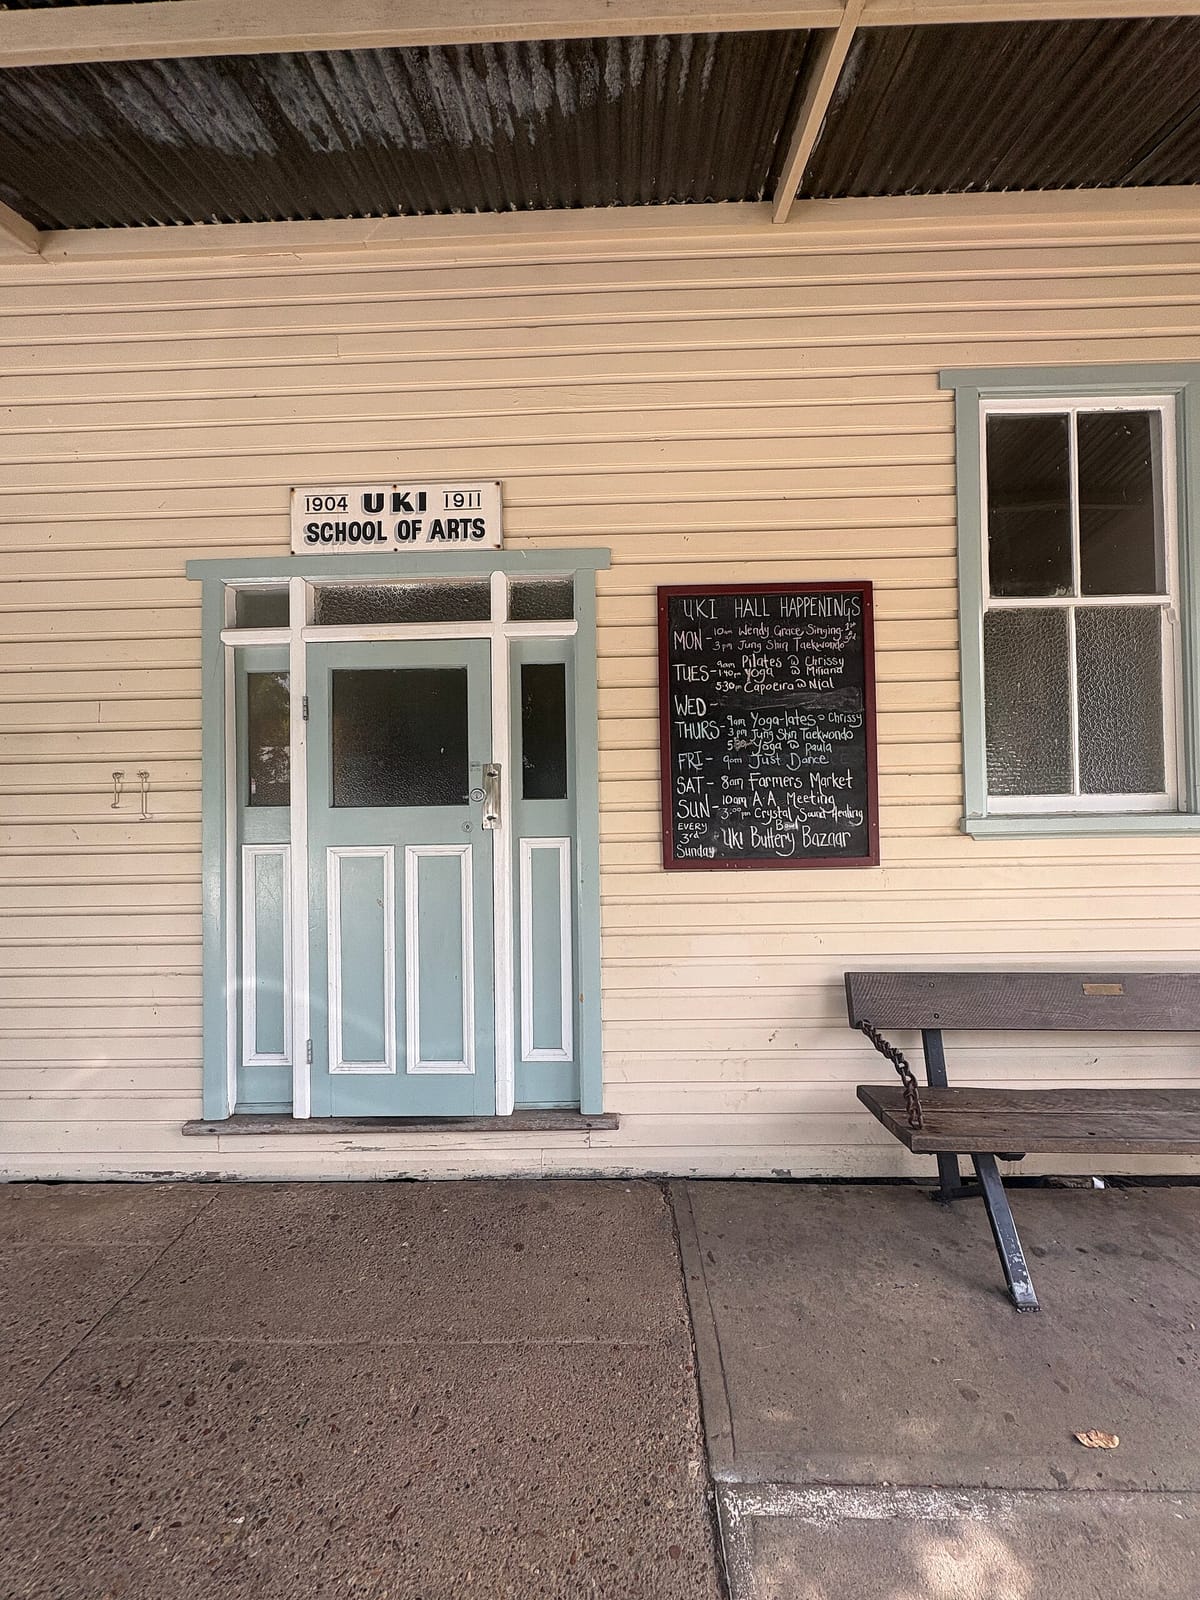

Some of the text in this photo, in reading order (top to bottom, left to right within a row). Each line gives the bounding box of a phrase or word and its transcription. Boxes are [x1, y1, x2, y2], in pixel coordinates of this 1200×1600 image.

[306, 492, 481, 514] 1904 UKI 1911
[305, 518, 486, 544] SCHOOL OF ARTS
[683, 596, 861, 621] UKI HALL HAPPENINGS
[673, 629, 702, 650] MON
[738, 622, 770, 639] Wendy
[737, 641, 762, 653] Jung
[765, 639, 789, 652] Shin
[793, 637, 845, 651] Taekwondo
[716, 660, 735, 668] 9am
[742, 653, 782, 669] Pilates
[805, 655, 844, 668] Chrissy
[743, 680, 794, 695] Capoeira
[674, 694, 707, 716] WED
[726, 715, 746, 727] 9am
[828, 712, 862, 728] Chrissy
[750, 728, 774, 743] Jung
[776, 727, 797, 740] Shin
[800, 727, 854, 741] Taekwondo
[678, 751, 703, 770] FRI
[722, 752, 830, 771] 9am Just Dance
[676, 776, 704, 794] SAT
[721, 768, 854, 791] 8am Farmers Market
[722, 794, 747, 808] 10am
[787, 791, 836, 810] Meeting
[754, 806, 793, 825] Crystal
[797, 806, 827, 822] Sound
[680, 831, 700, 844] 3rd
[750, 826, 795, 856] Buttery
[802, 825, 852, 848] Bazaar
[676, 844, 716, 858] Sunday
